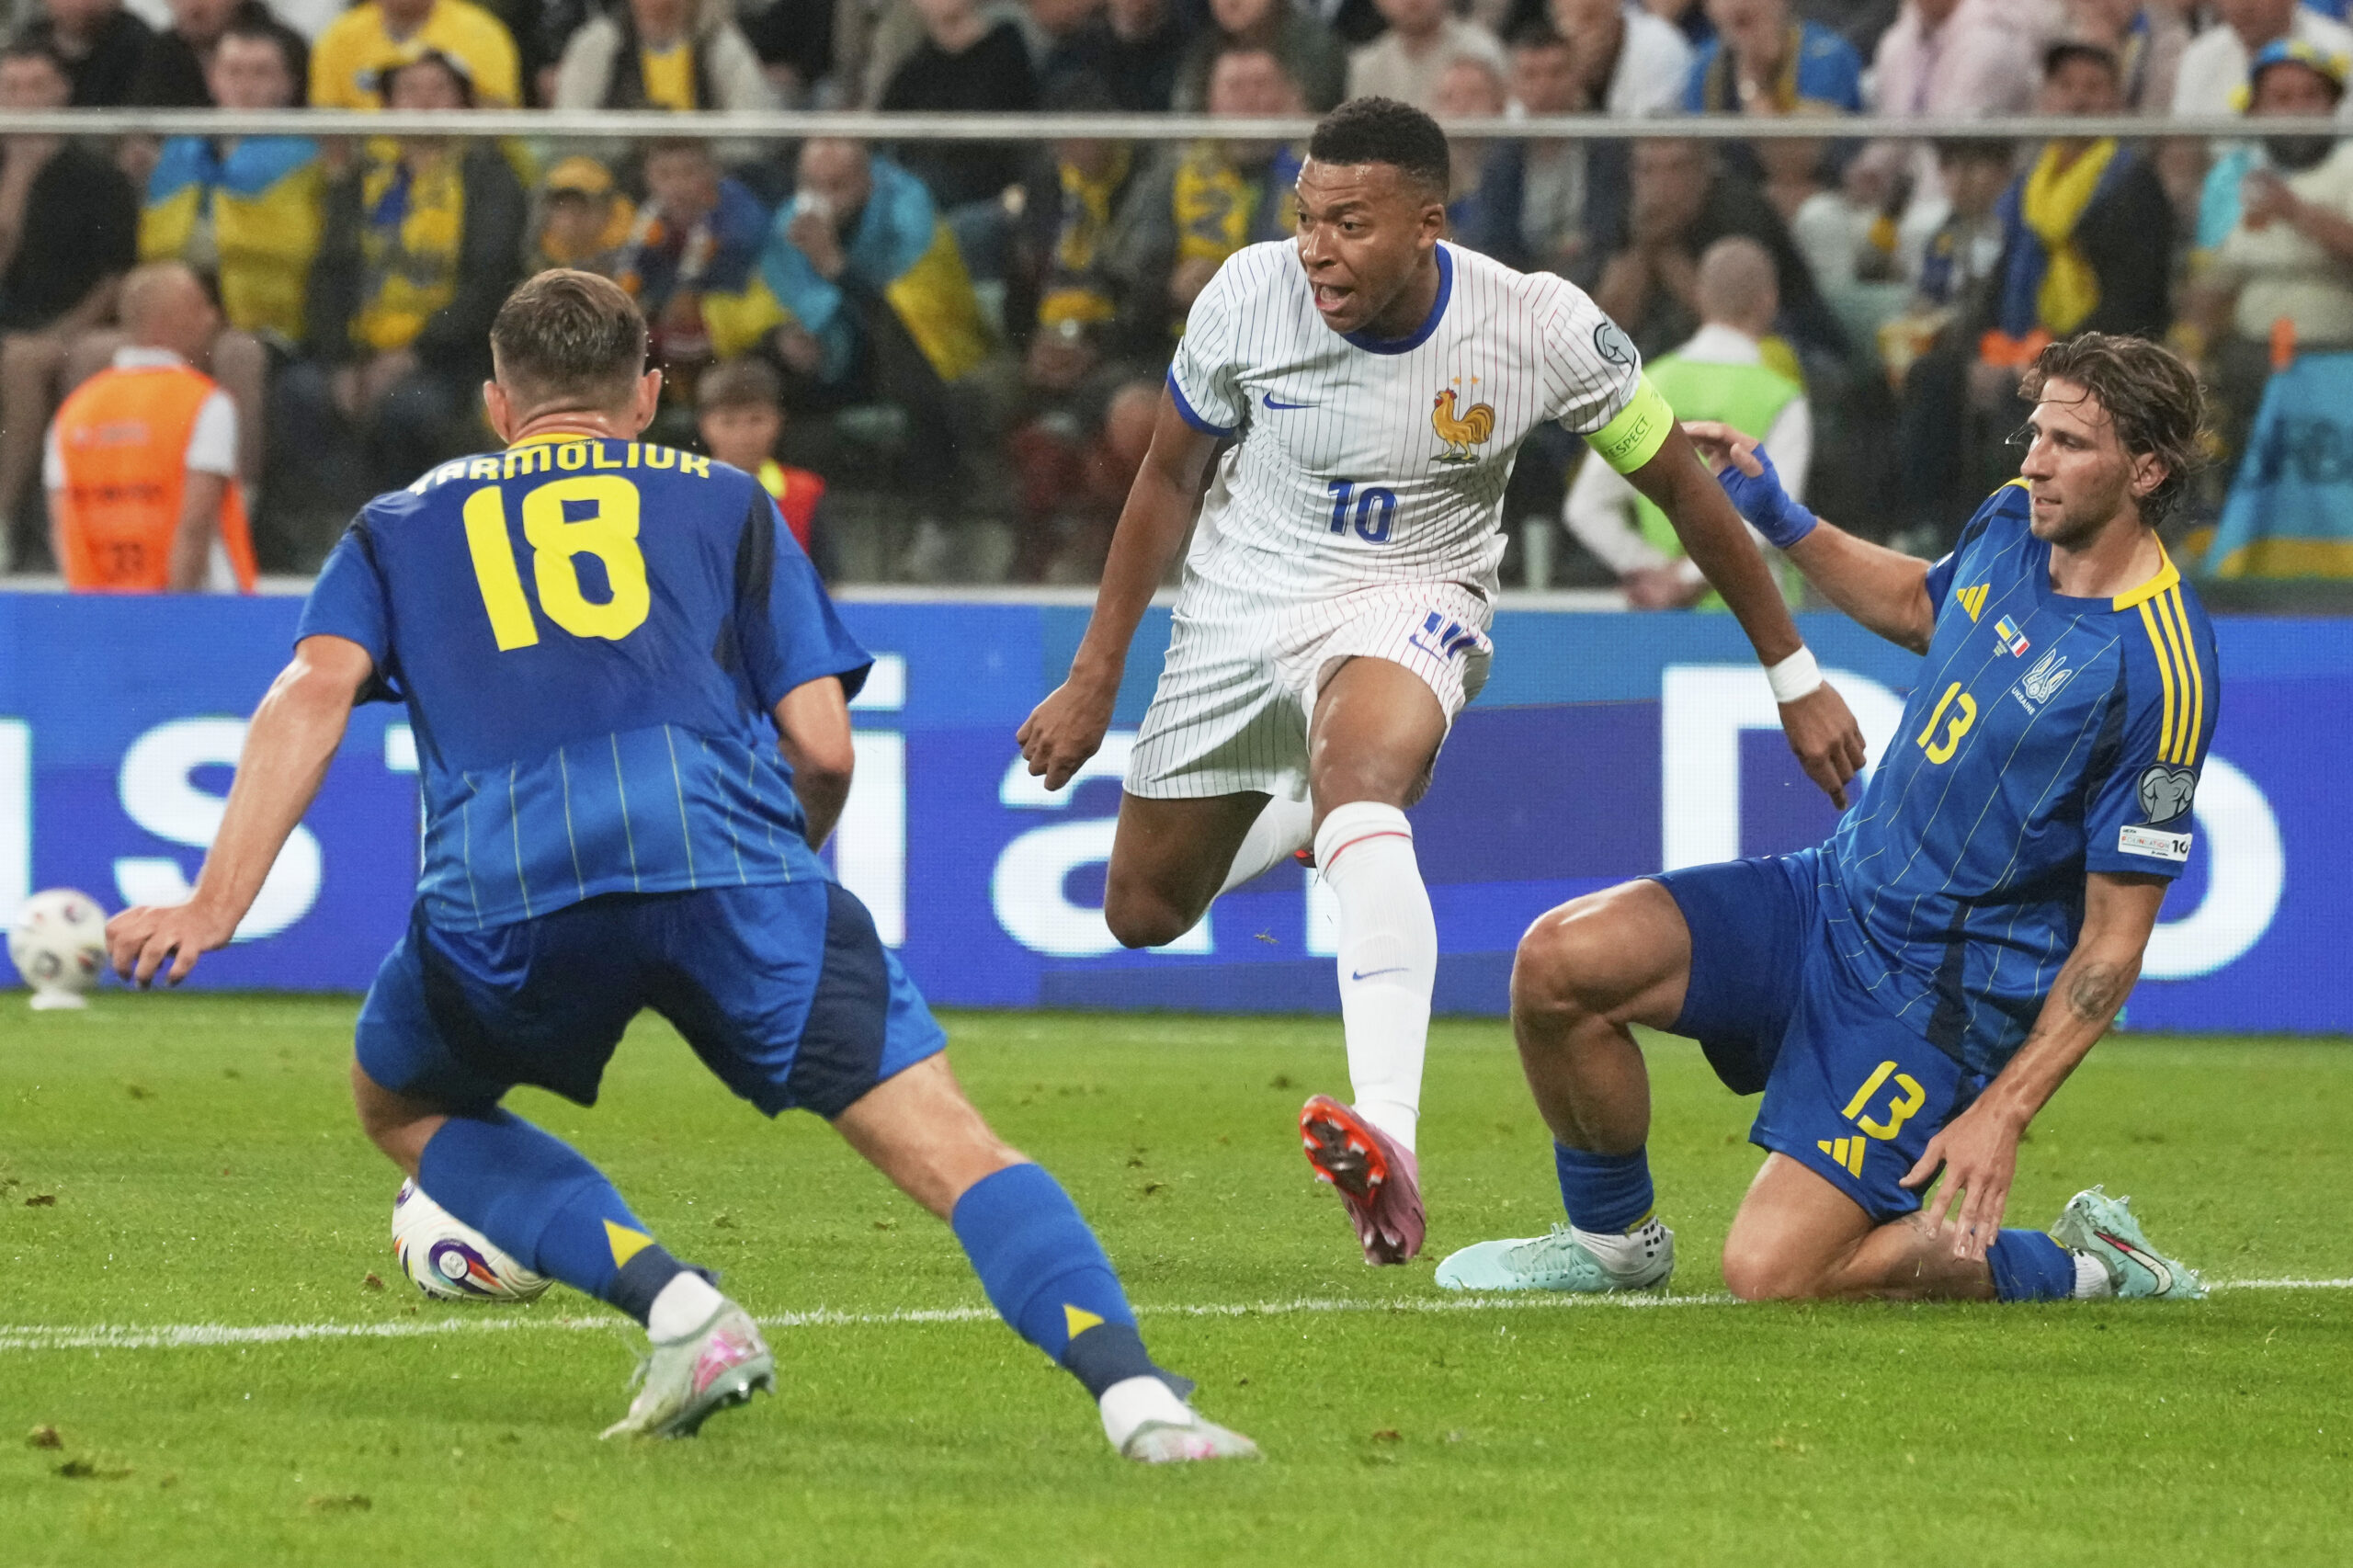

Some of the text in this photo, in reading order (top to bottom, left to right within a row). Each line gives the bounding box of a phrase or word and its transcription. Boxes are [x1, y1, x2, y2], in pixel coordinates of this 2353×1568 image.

[1327, 477, 1398, 545] 10
[462, 474, 651, 653] 18
[1915, 672, 1977, 765] 13
[2011, 686, 2036, 716] UKRAINE
[1841, 1060, 1927, 1141] 13
